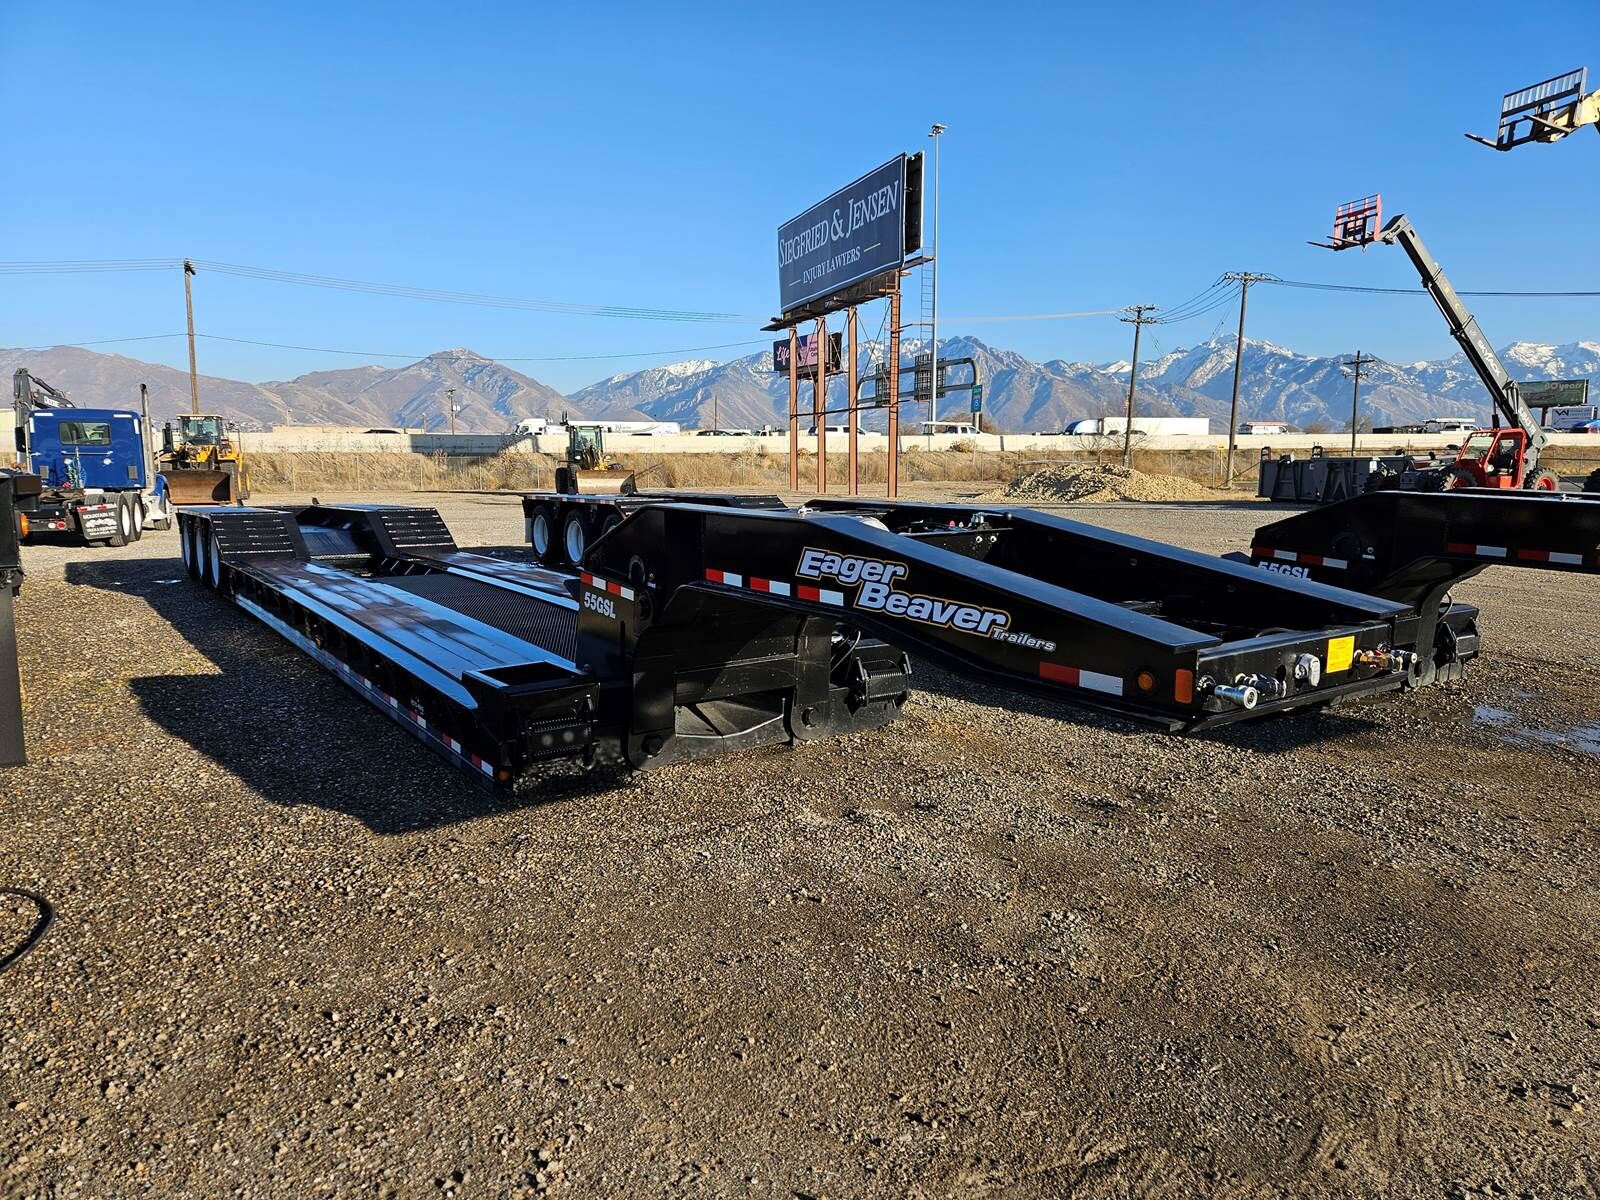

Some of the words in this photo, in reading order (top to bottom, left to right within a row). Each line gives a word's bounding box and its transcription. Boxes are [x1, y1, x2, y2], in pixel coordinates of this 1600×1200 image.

[780, 220, 829, 269] SIEGFRIED
[830, 208, 845, 241] &
[846, 180, 899, 238] JENSEN
[802, 262, 826, 284] INJURY
[826, 246, 861, 273] LAWYERS
[797, 548, 907, 585] Eager
[583, 591, 616, 619] 55GSL
[855, 580, 1009, 635] Beaver
[992, 626, 1057, 651] Trailers
